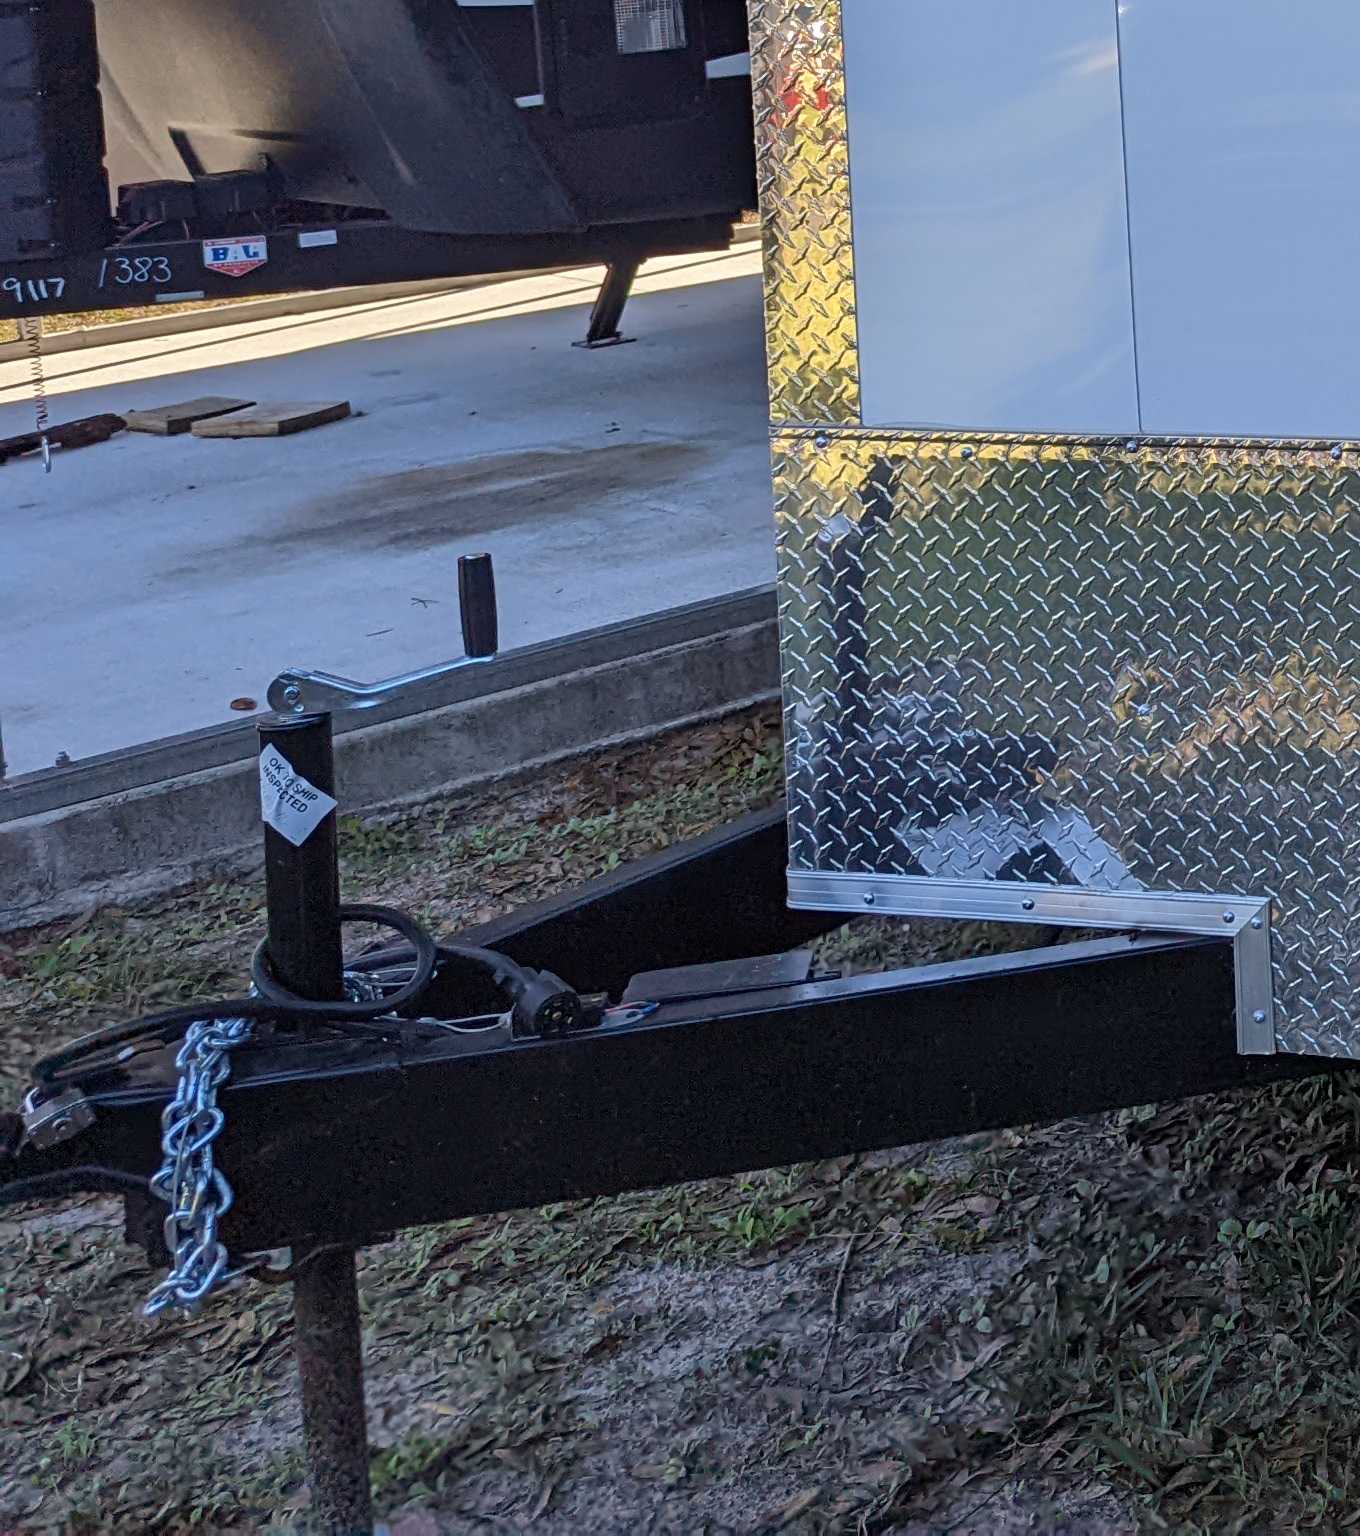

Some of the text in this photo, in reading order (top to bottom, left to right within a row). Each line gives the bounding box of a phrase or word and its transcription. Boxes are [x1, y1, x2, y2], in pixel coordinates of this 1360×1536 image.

[263, 763, 308, 813] INSPECTED
[269, 757, 286, 775] OK
[292, 783, 319, 802] SHIP
